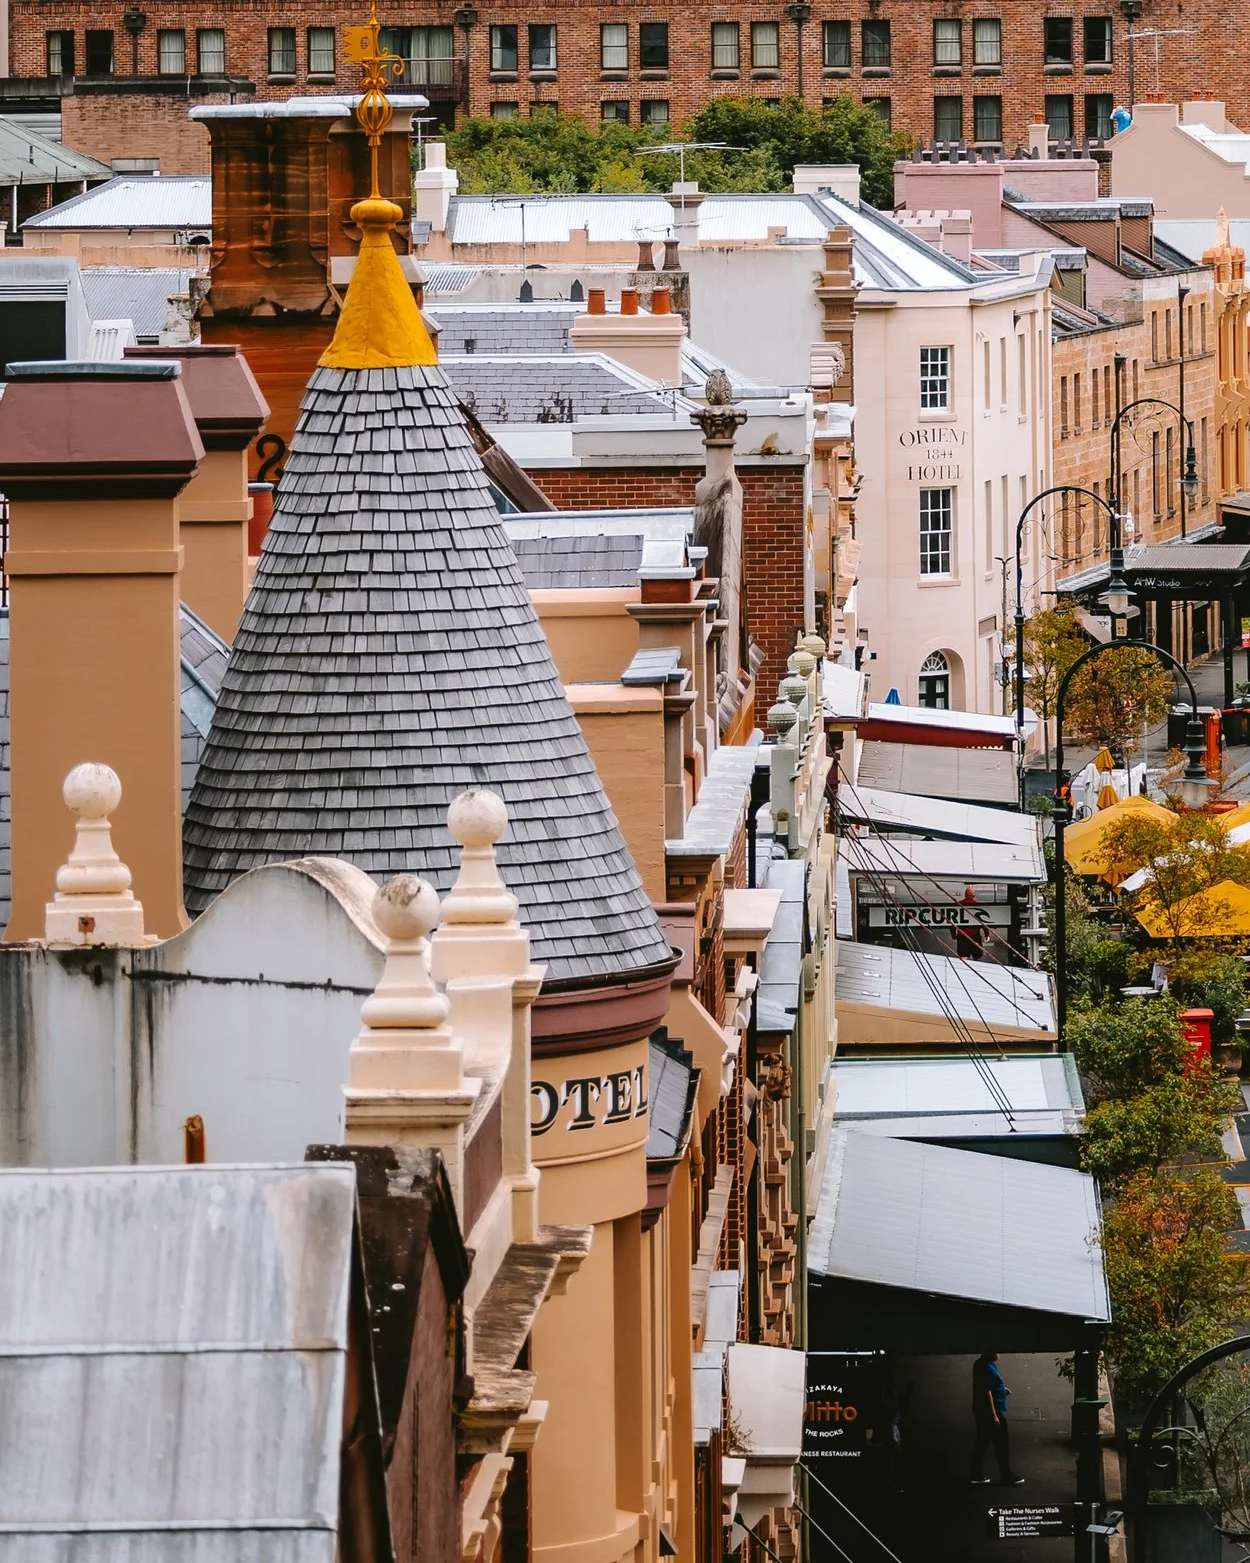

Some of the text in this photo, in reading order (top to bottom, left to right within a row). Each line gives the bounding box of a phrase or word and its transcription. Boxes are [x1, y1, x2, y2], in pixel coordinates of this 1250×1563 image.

[899, 427, 968, 447] ORIENT
[907, 464, 965, 480] HOTEL
[1157, 577, 1180, 587] Studio
[531, 1064, 648, 1137] OTEL
[805, 1428, 844, 1438] THE ROCKS
